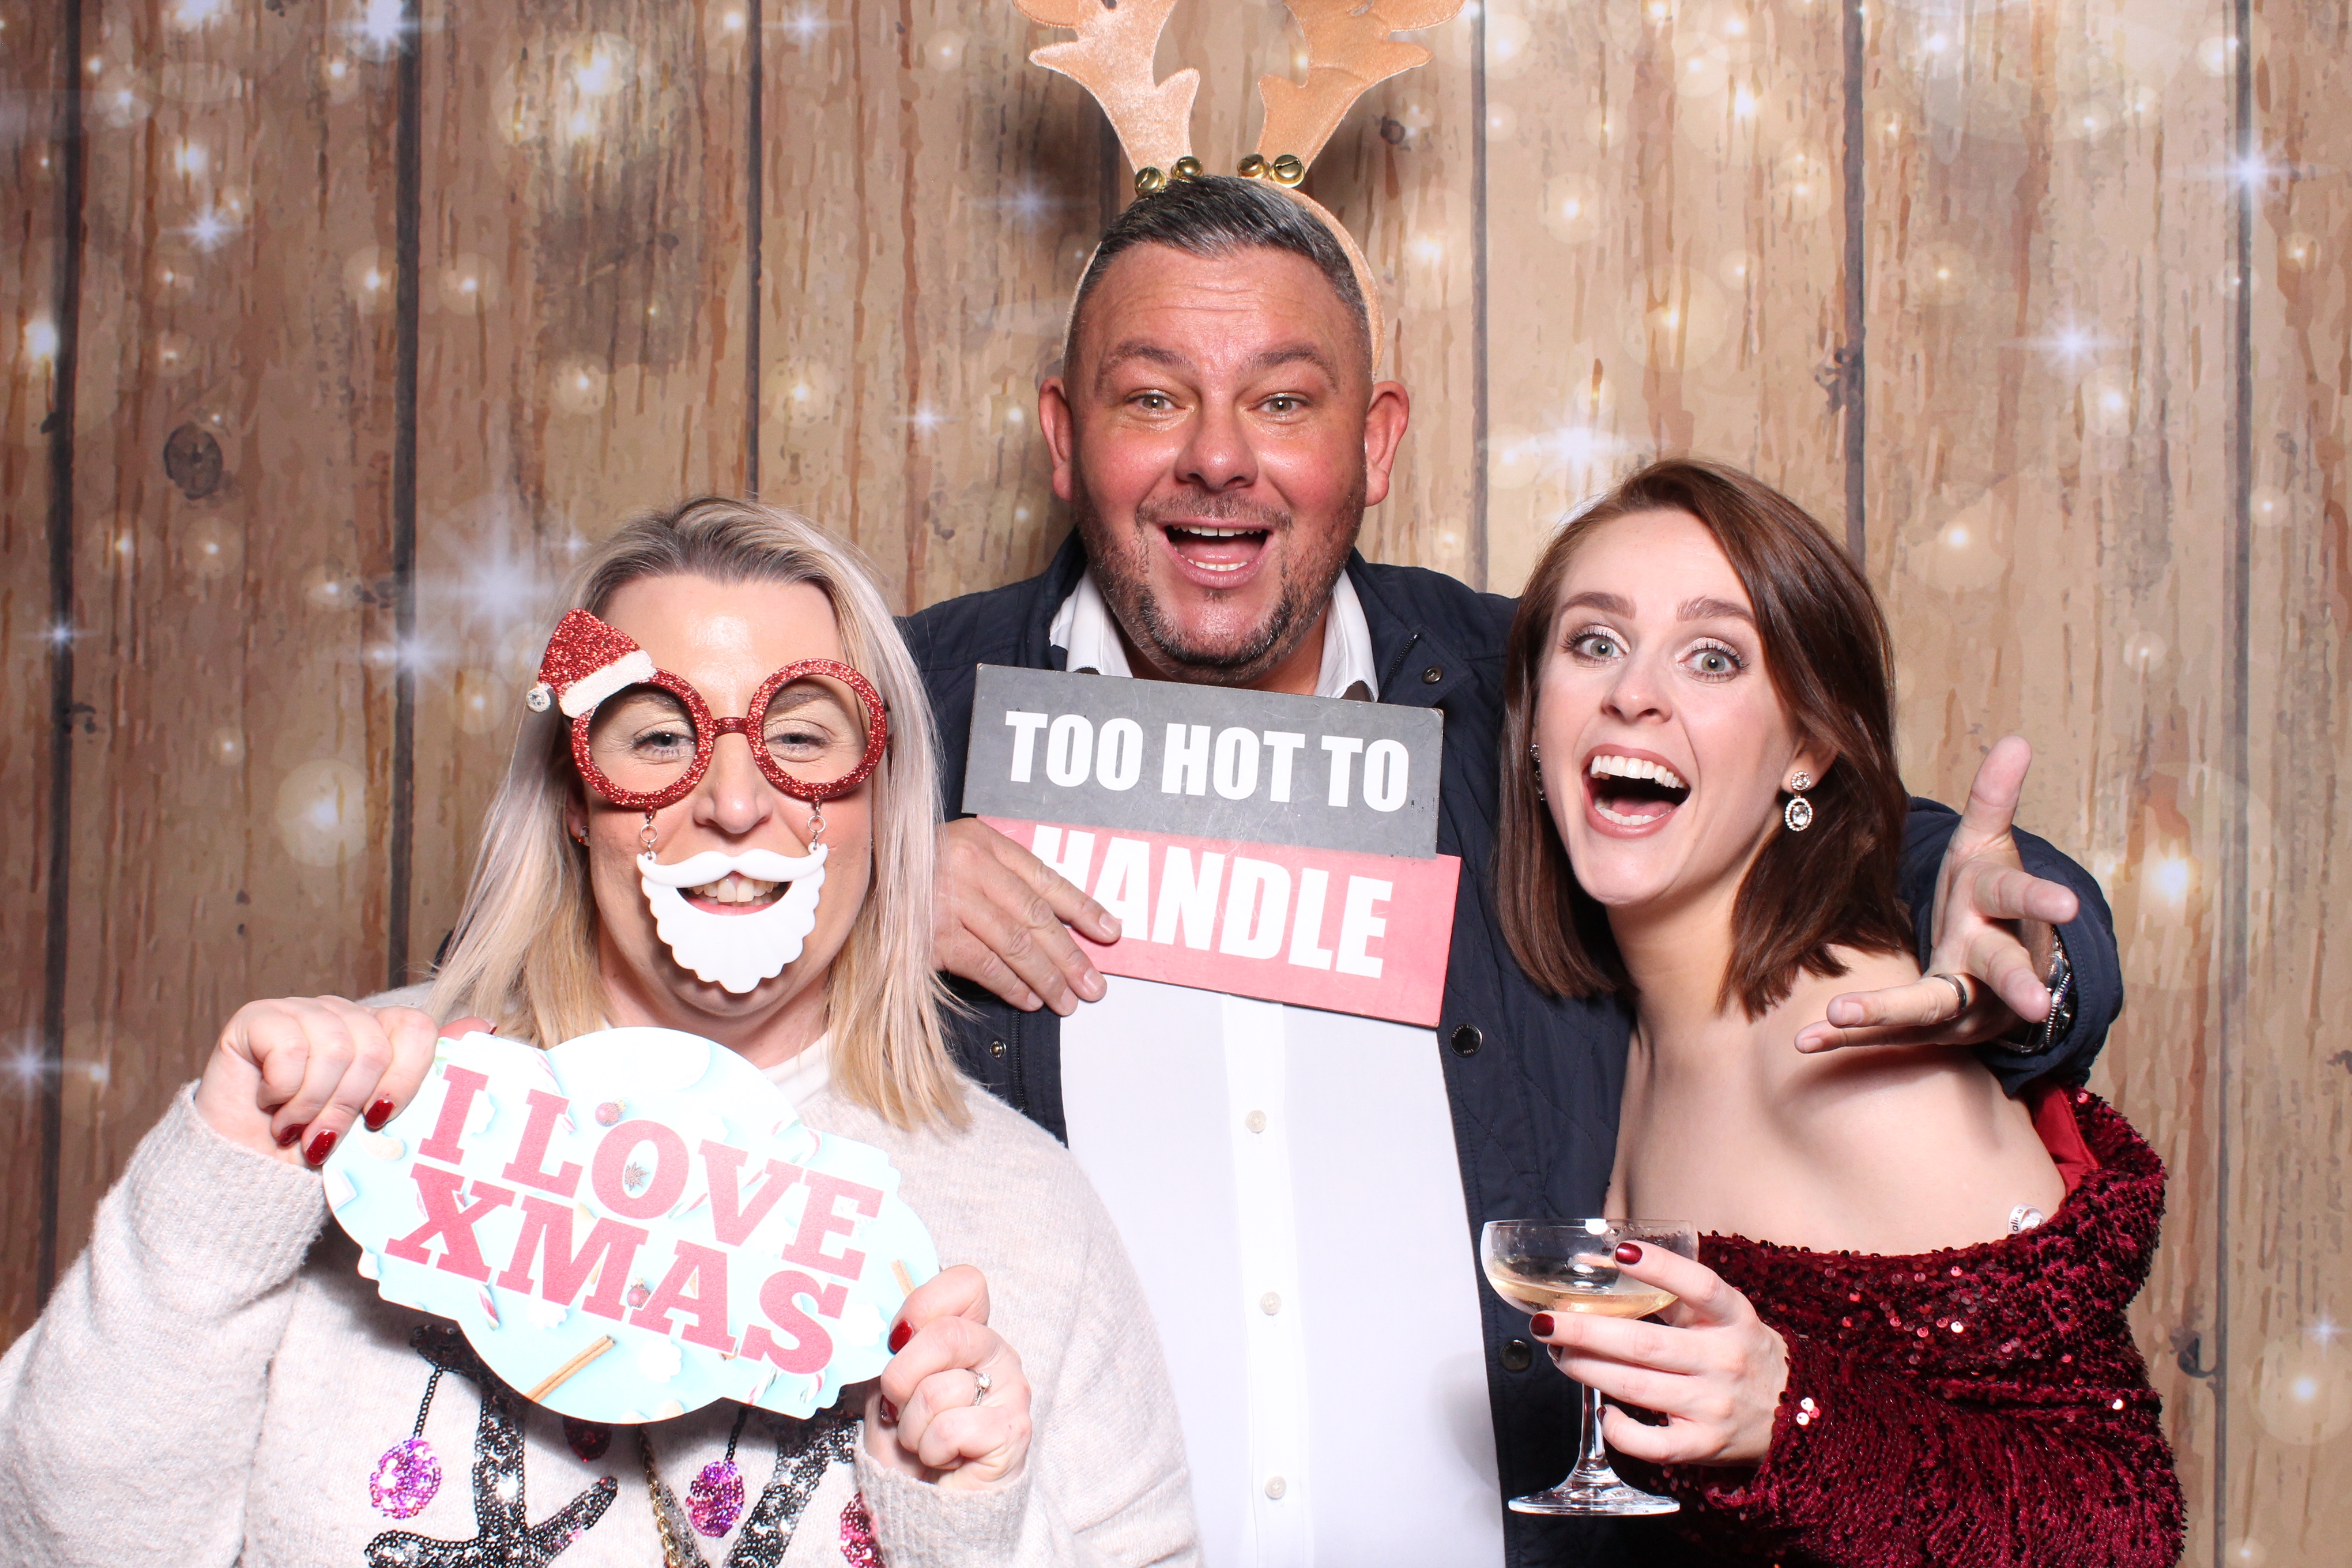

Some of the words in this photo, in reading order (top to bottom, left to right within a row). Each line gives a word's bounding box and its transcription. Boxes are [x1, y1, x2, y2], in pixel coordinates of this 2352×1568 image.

[1005, 710, 1143, 791] TOO
[1160, 723, 1306, 803] HOT
[1321, 735, 1409, 813] TO
[385, 1162, 850, 1375] XMAS
[419, 1065, 489, 1166] I
[502, 1089, 885, 1281] LOVE
